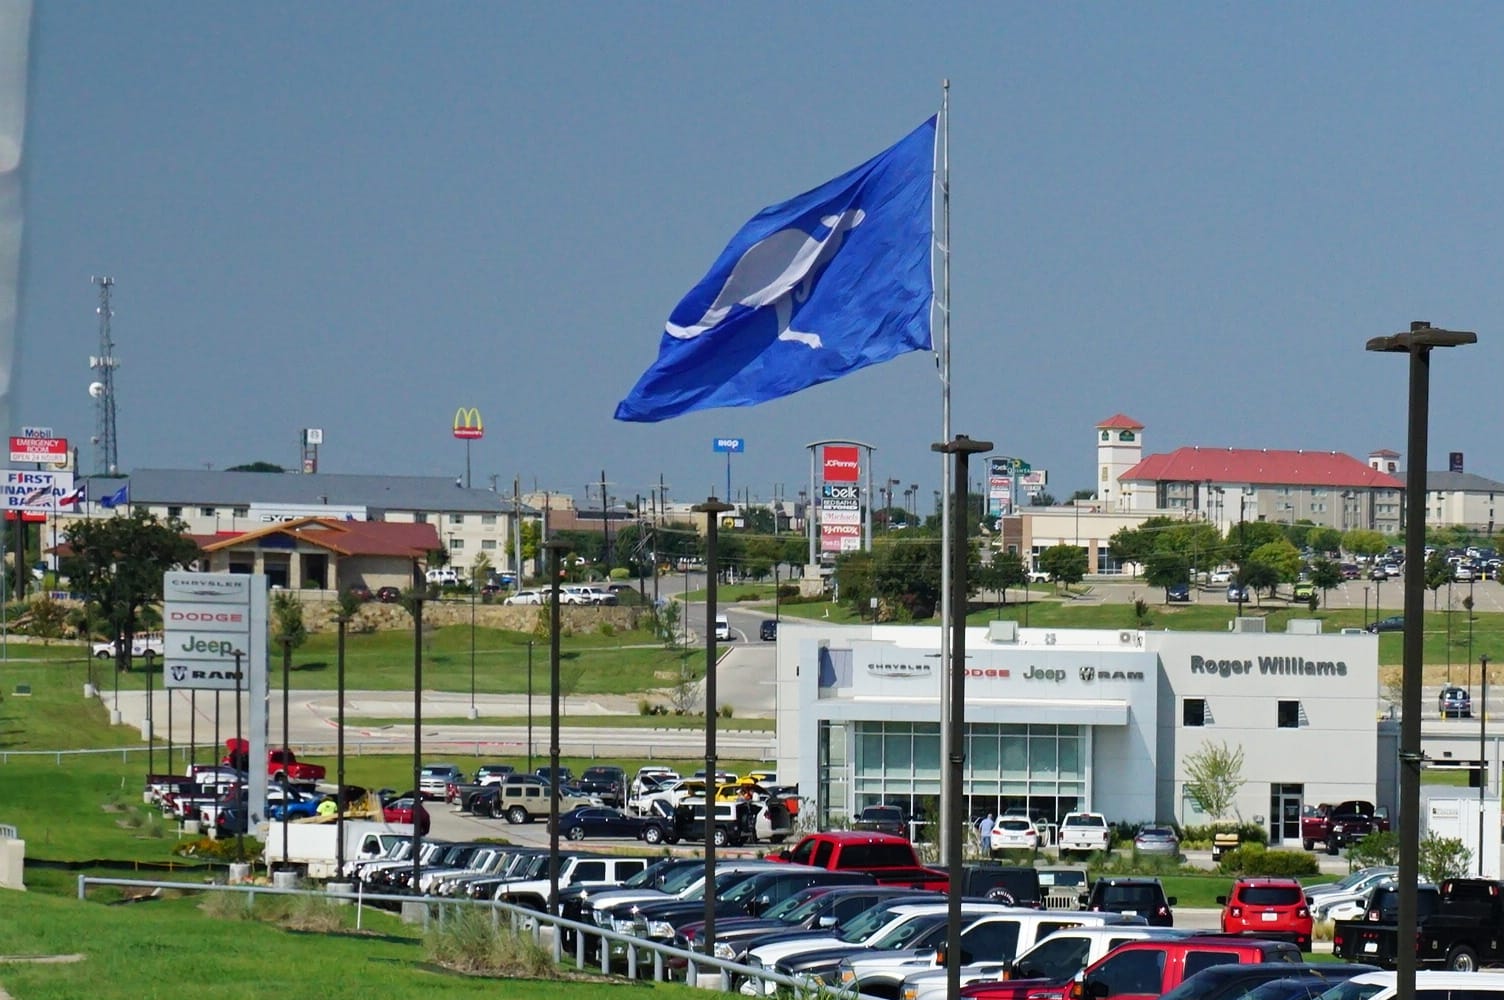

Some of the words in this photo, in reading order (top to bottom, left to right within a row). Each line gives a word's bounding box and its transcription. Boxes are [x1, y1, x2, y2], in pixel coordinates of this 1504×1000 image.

[25, 429, 51, 438] Mobil
[16, 439, 59, 447] EMERGENCY
[8, 472, 52, 484] FIRST
[832, 486, 857, 498] belk
[171, 580, 242, 588] CHRYSLER
[170, 612, 243, 623] DODGE
[181, 635, 232, 657] Jeep
[867, 663, 931, 671] CHRYSLER
[1190, 655, 1253, 678] Roger
[1257, 655, 1348, 677] Williams
[191, 670, 244, 680] RAM
[1022, 665, 1067, 683] Jeep
[1097, 670, 1144, 680] RAM
